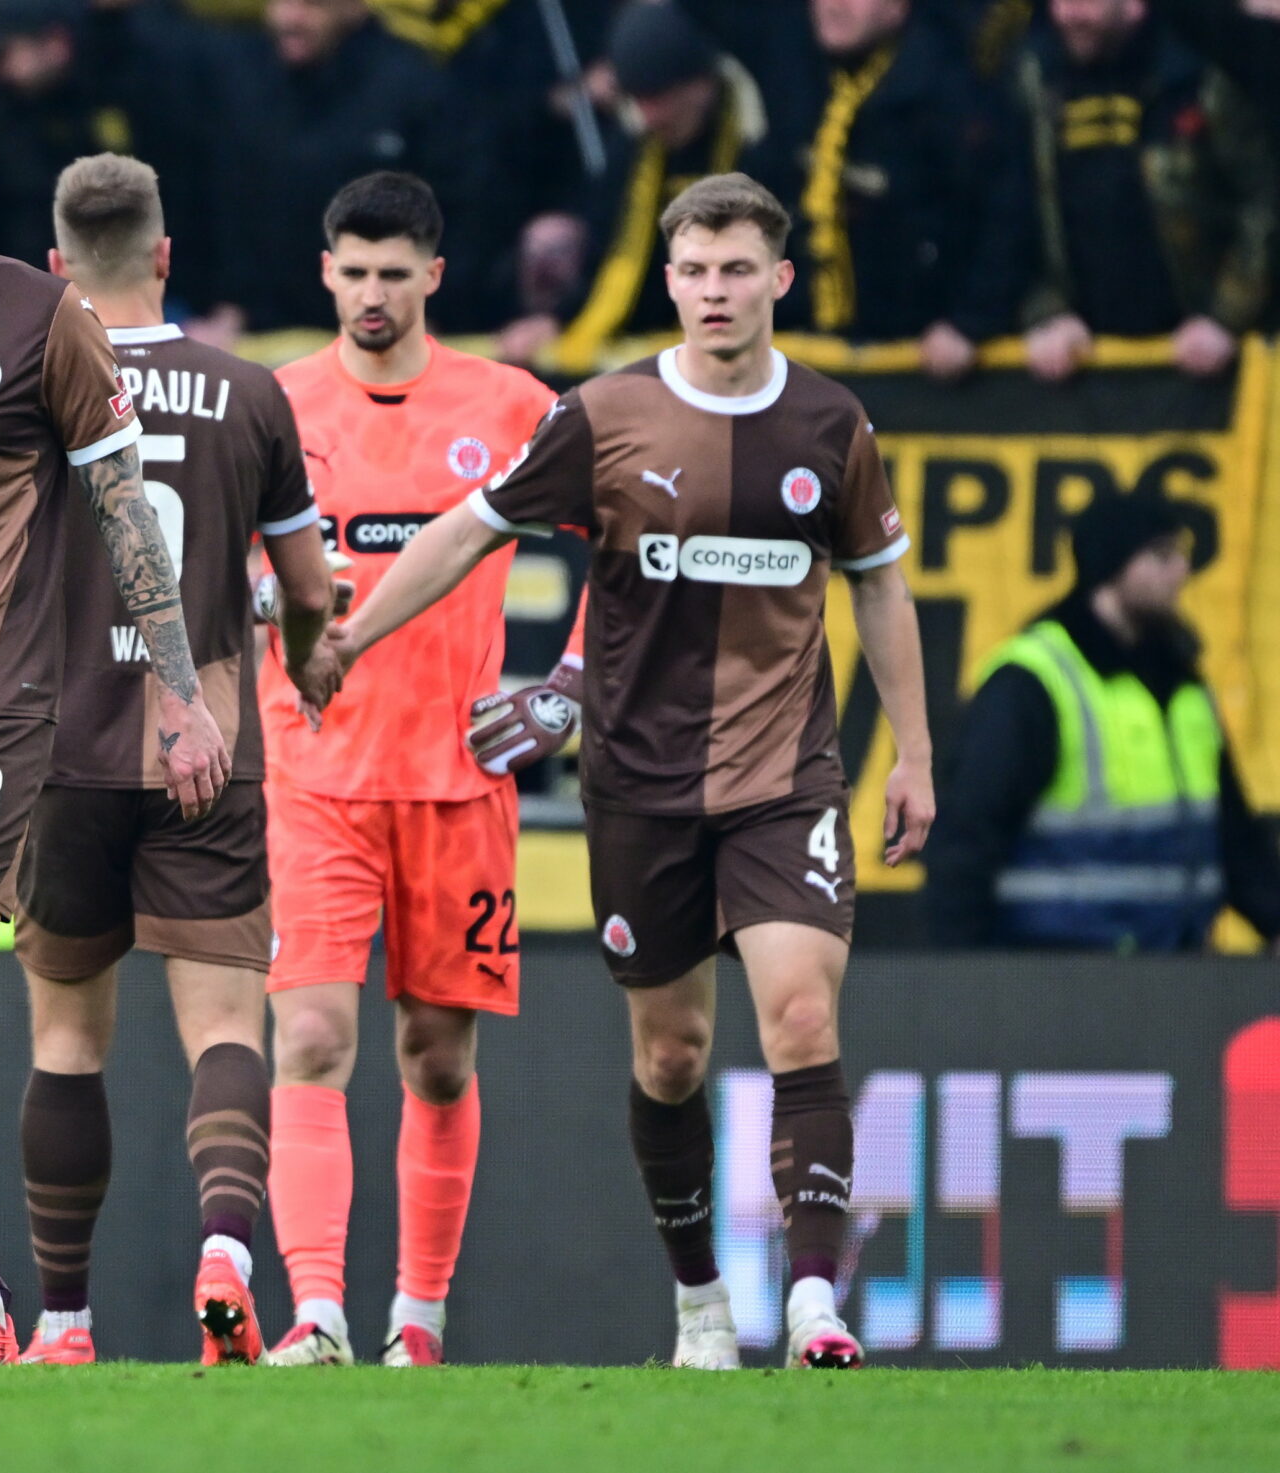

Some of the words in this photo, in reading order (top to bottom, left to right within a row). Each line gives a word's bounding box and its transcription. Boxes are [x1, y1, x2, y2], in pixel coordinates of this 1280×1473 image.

[120, 367, 230, 421] PAULI
[692, 549, 799, 575] congstar
[808, 807, 839, 873] 4
[465, 888, 519, 955] 22
